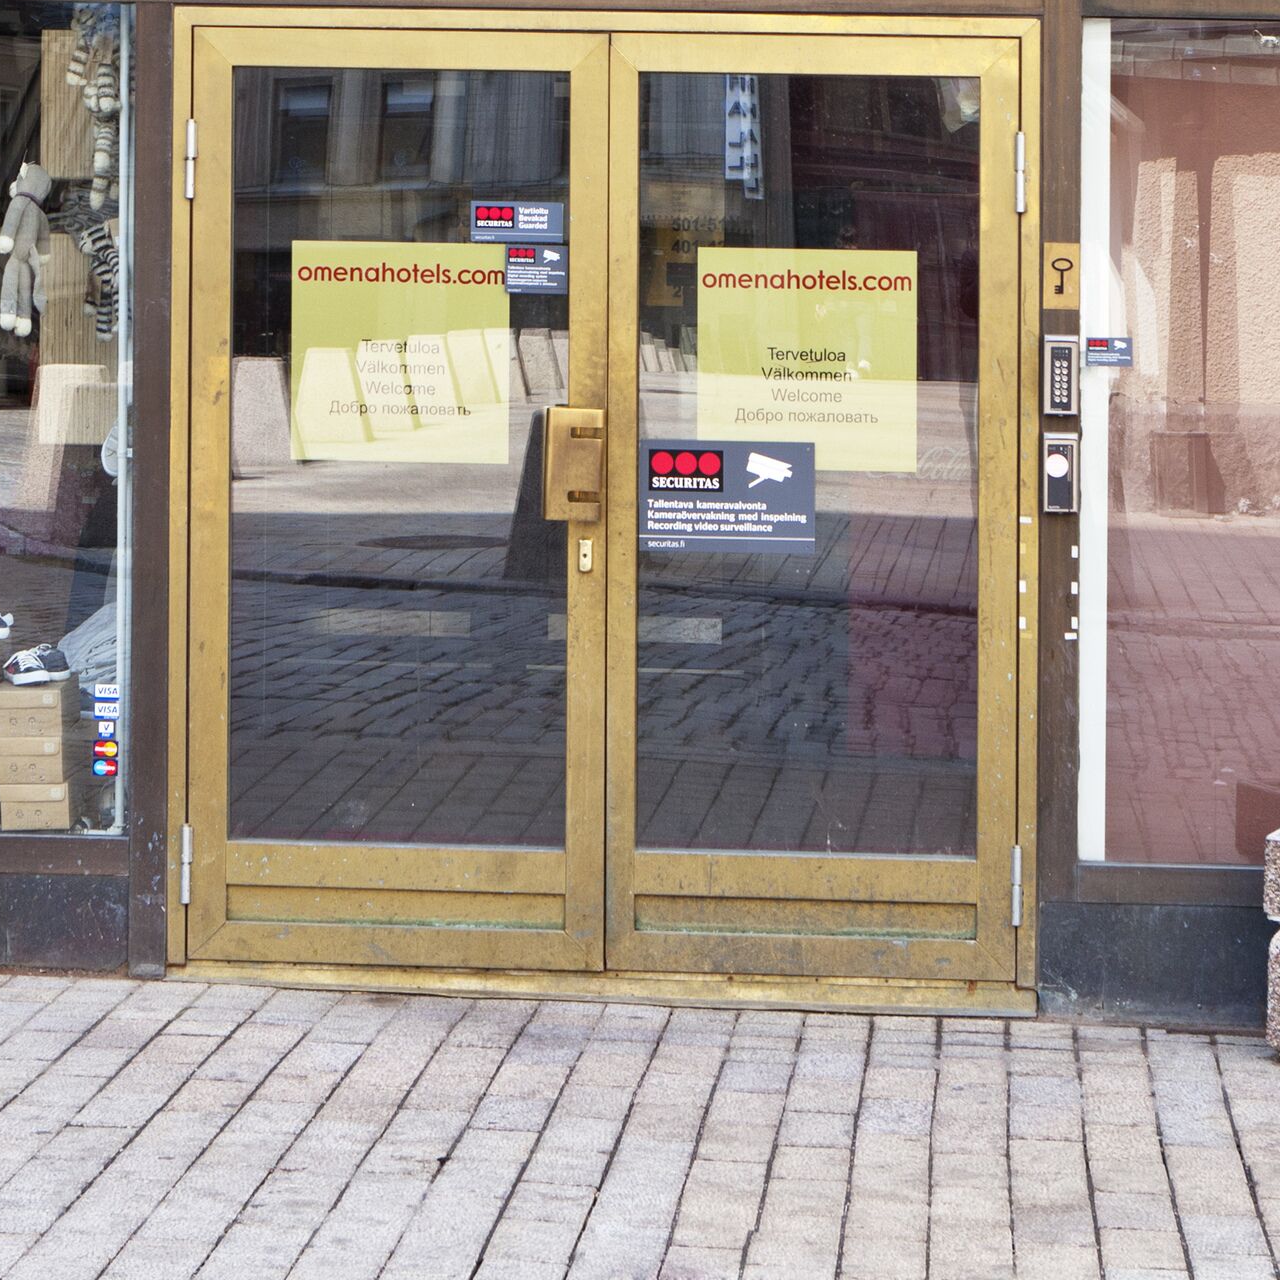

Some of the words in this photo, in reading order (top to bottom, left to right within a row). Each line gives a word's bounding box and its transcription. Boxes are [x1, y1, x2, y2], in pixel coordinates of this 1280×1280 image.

[476, 220, 513, 228] SECURITAS
[297, 262, 505, 286] omenahotels.com
[701, 269, 913, 292] omenahotels.com
[361, 338, 440, 354] Tervetuloa
[767, 346, 847, 363] Tervetuloa
[356, 359, 446, 375] Välkommen
[760, 366, 853, 382] Välkommen
[365, 381, 436, 396] Welcome
[771, 388, 843, 403] Welcome
[328, 399, 378, 417] Добро
[734, 407, 784, 425] Добро
[787, 411, 879, 424] пожаловать
[651, 476, 720, 490] SECURITAS
[647, 499, 694, 509] Tallentava
[696, 500, 767, 511] kameravalvonta
[647, 510, 736, 522] Kameraövervakning
[738, 512, 759, 521] med
[760, 513, 807, 524] inspelning
[647, 520, 693, 532] Recording
[694, 521, 719, 531] video
[720, 522, 773, 533] surveillance
[647, 539, 686, 548] securitas.fi
[97, 687, 118, 695] VISA
[97, 705, 118, 713] VISA
